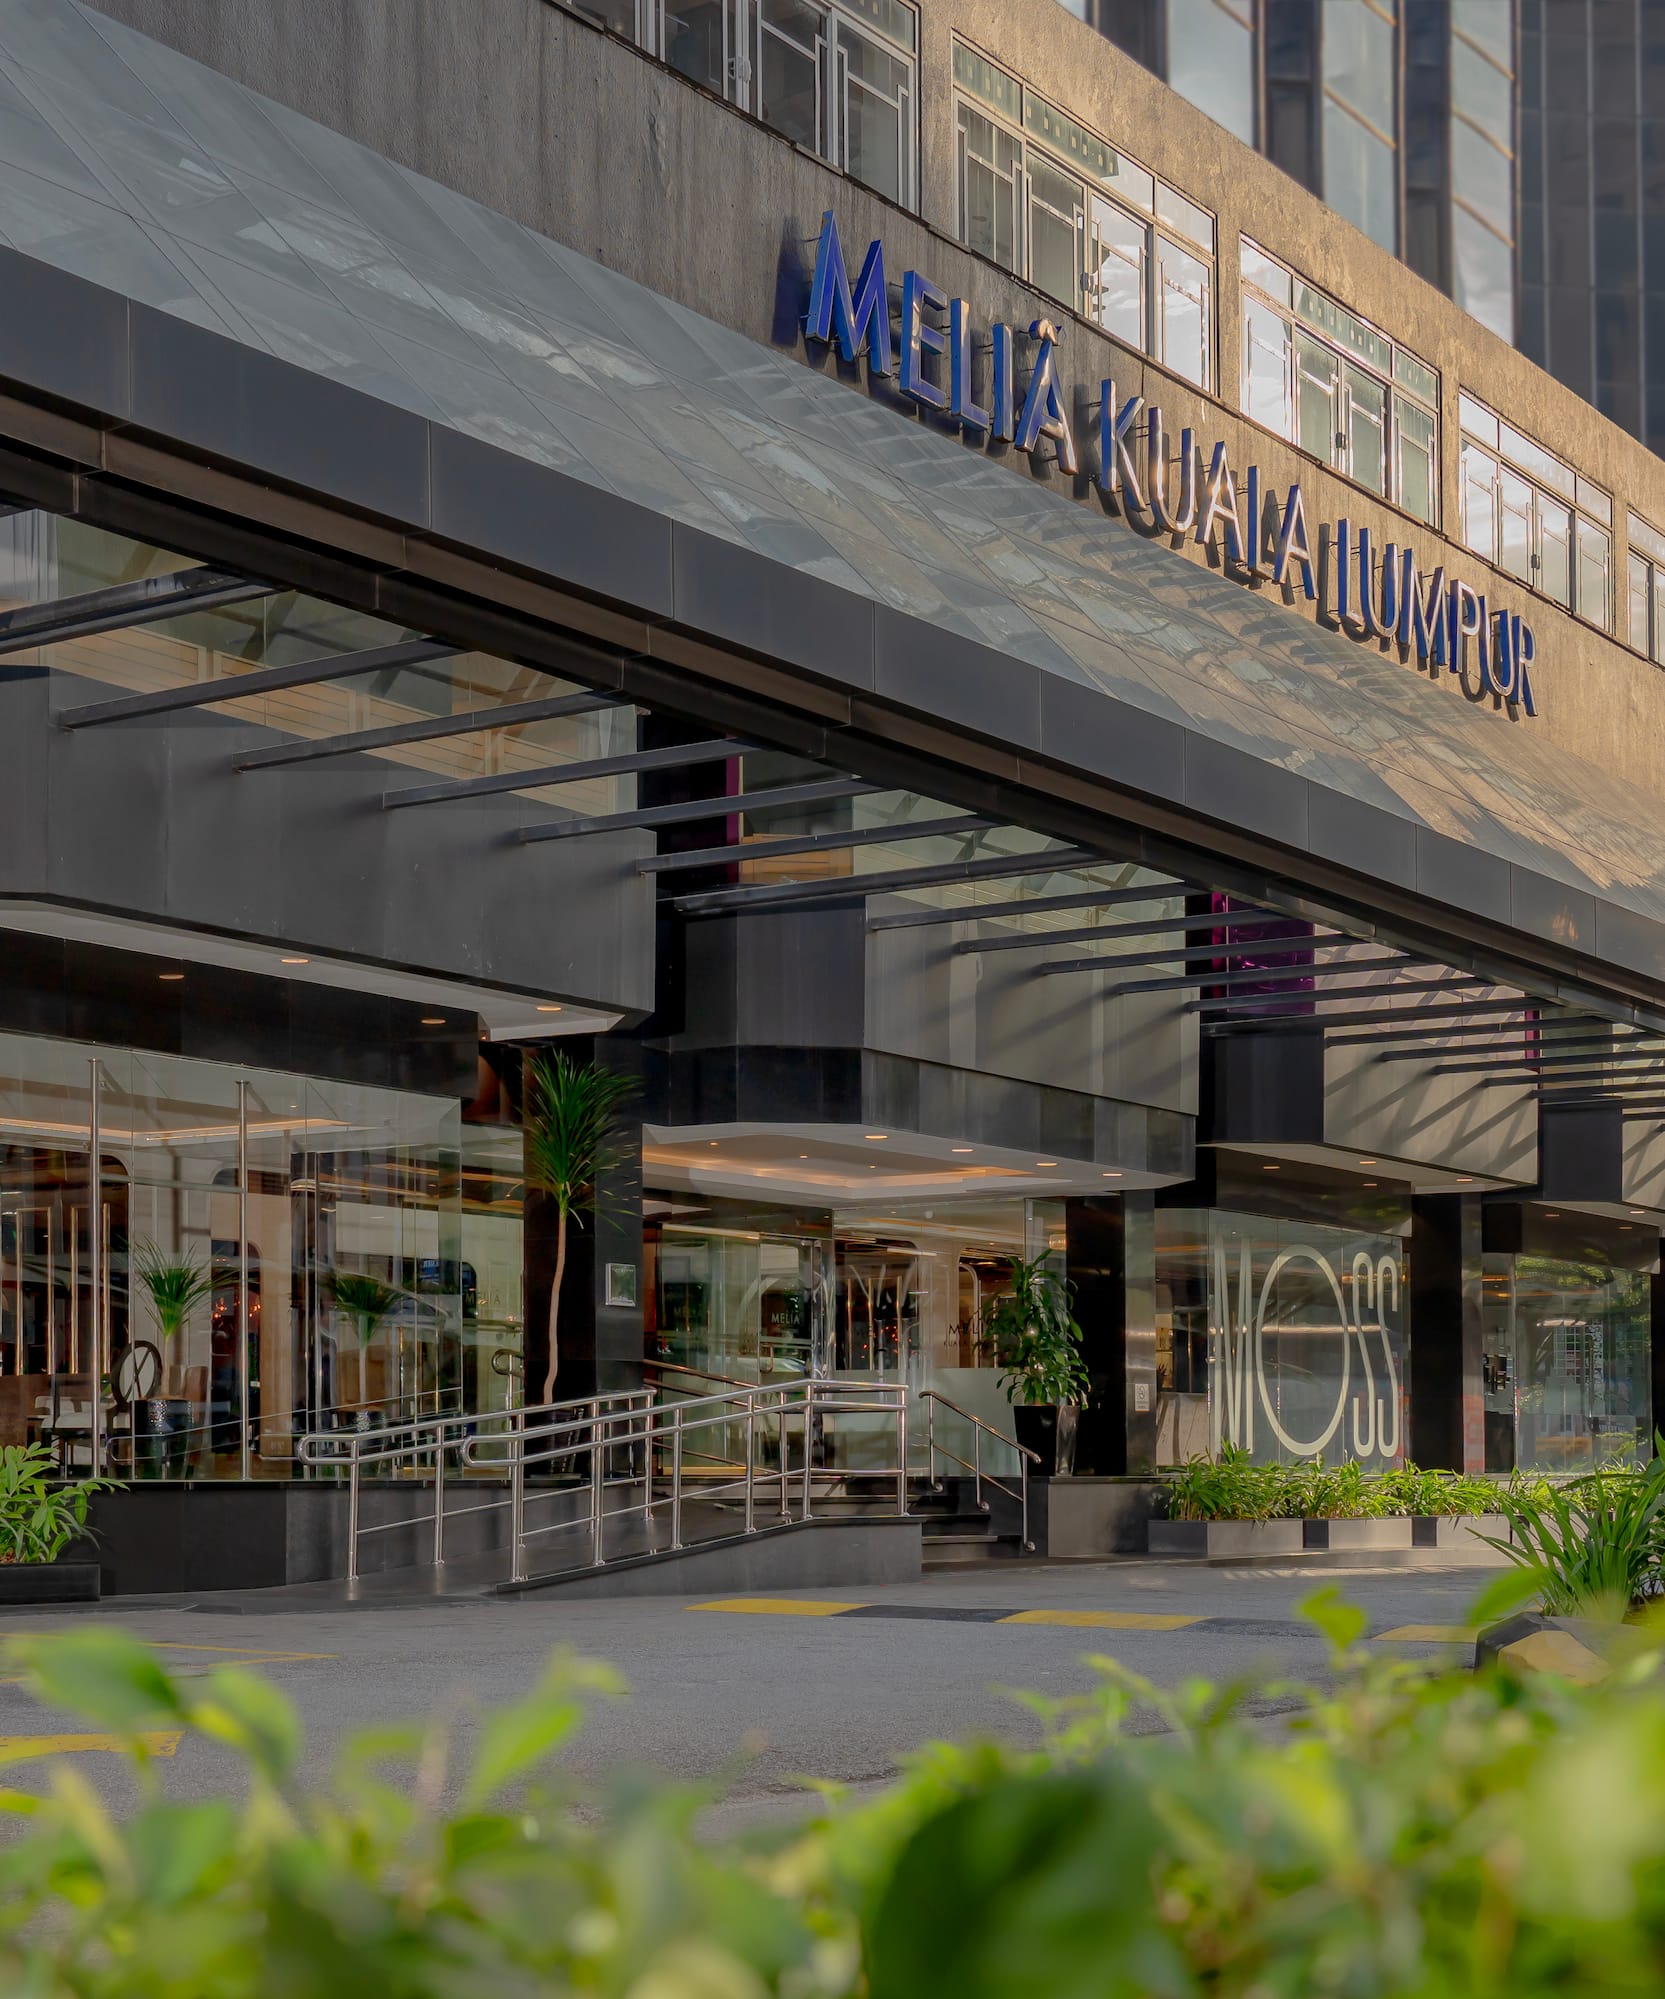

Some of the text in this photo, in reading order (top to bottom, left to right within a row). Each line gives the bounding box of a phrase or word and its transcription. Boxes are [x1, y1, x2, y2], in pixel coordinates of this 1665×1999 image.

[1100, 378, 1318, 599] KUALA
[1338, 518, 1538, 717] LUMPUR
[1213, 1236, 1400, 1460] MOSS
